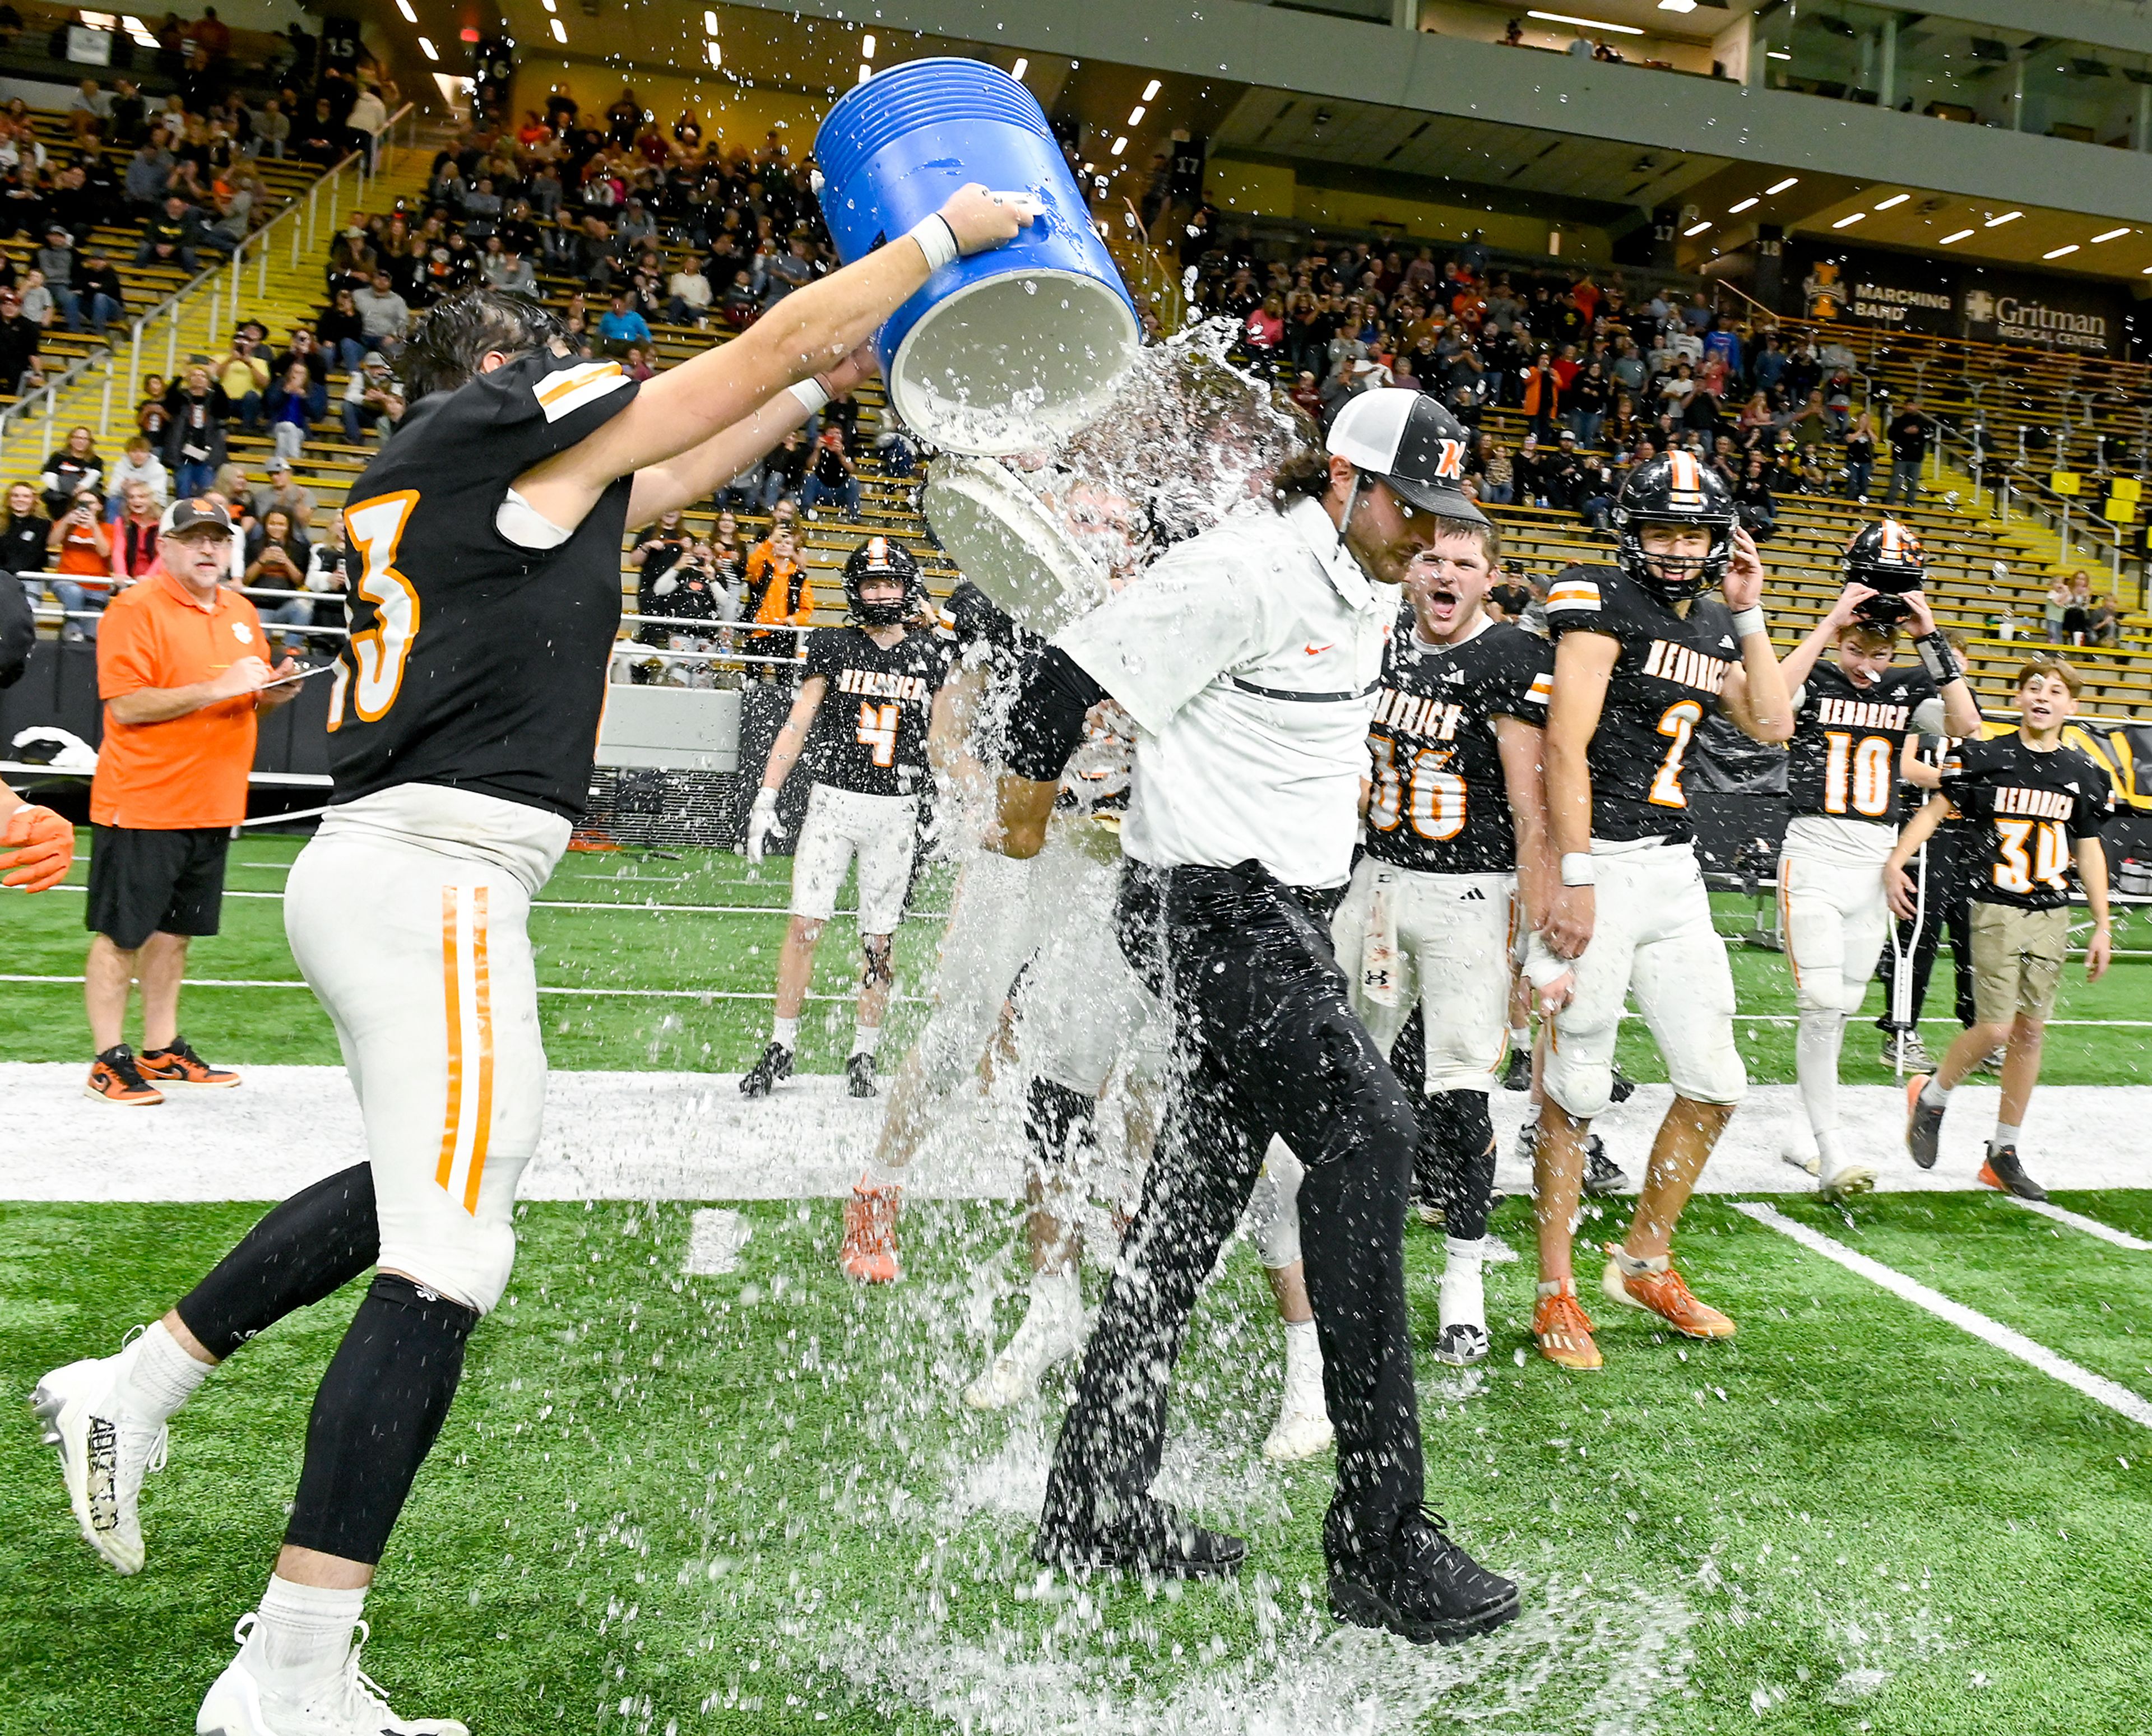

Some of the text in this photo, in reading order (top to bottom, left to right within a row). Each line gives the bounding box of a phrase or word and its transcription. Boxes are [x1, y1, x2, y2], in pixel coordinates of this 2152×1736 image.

[327, 37, 354, 57] 15
[477, 57, 507, 80] 16
[1177, 157, 1199, 174] 17
[1761, 240, 1781, 256] 18
[1855, 284, 1951, 310] MARCHING
[1996, 297, 2106, 336] Gritman
[1372, 688, 1464, 741] NDRICK
[1817, 697, 1910, 731] KENDRICK
[856, 702, 901, 767] 4
[1648, 700, 1704, 809] 2
[1824, 731, 1893, 816] 10
[1992, 818, 2070, 894] 34
